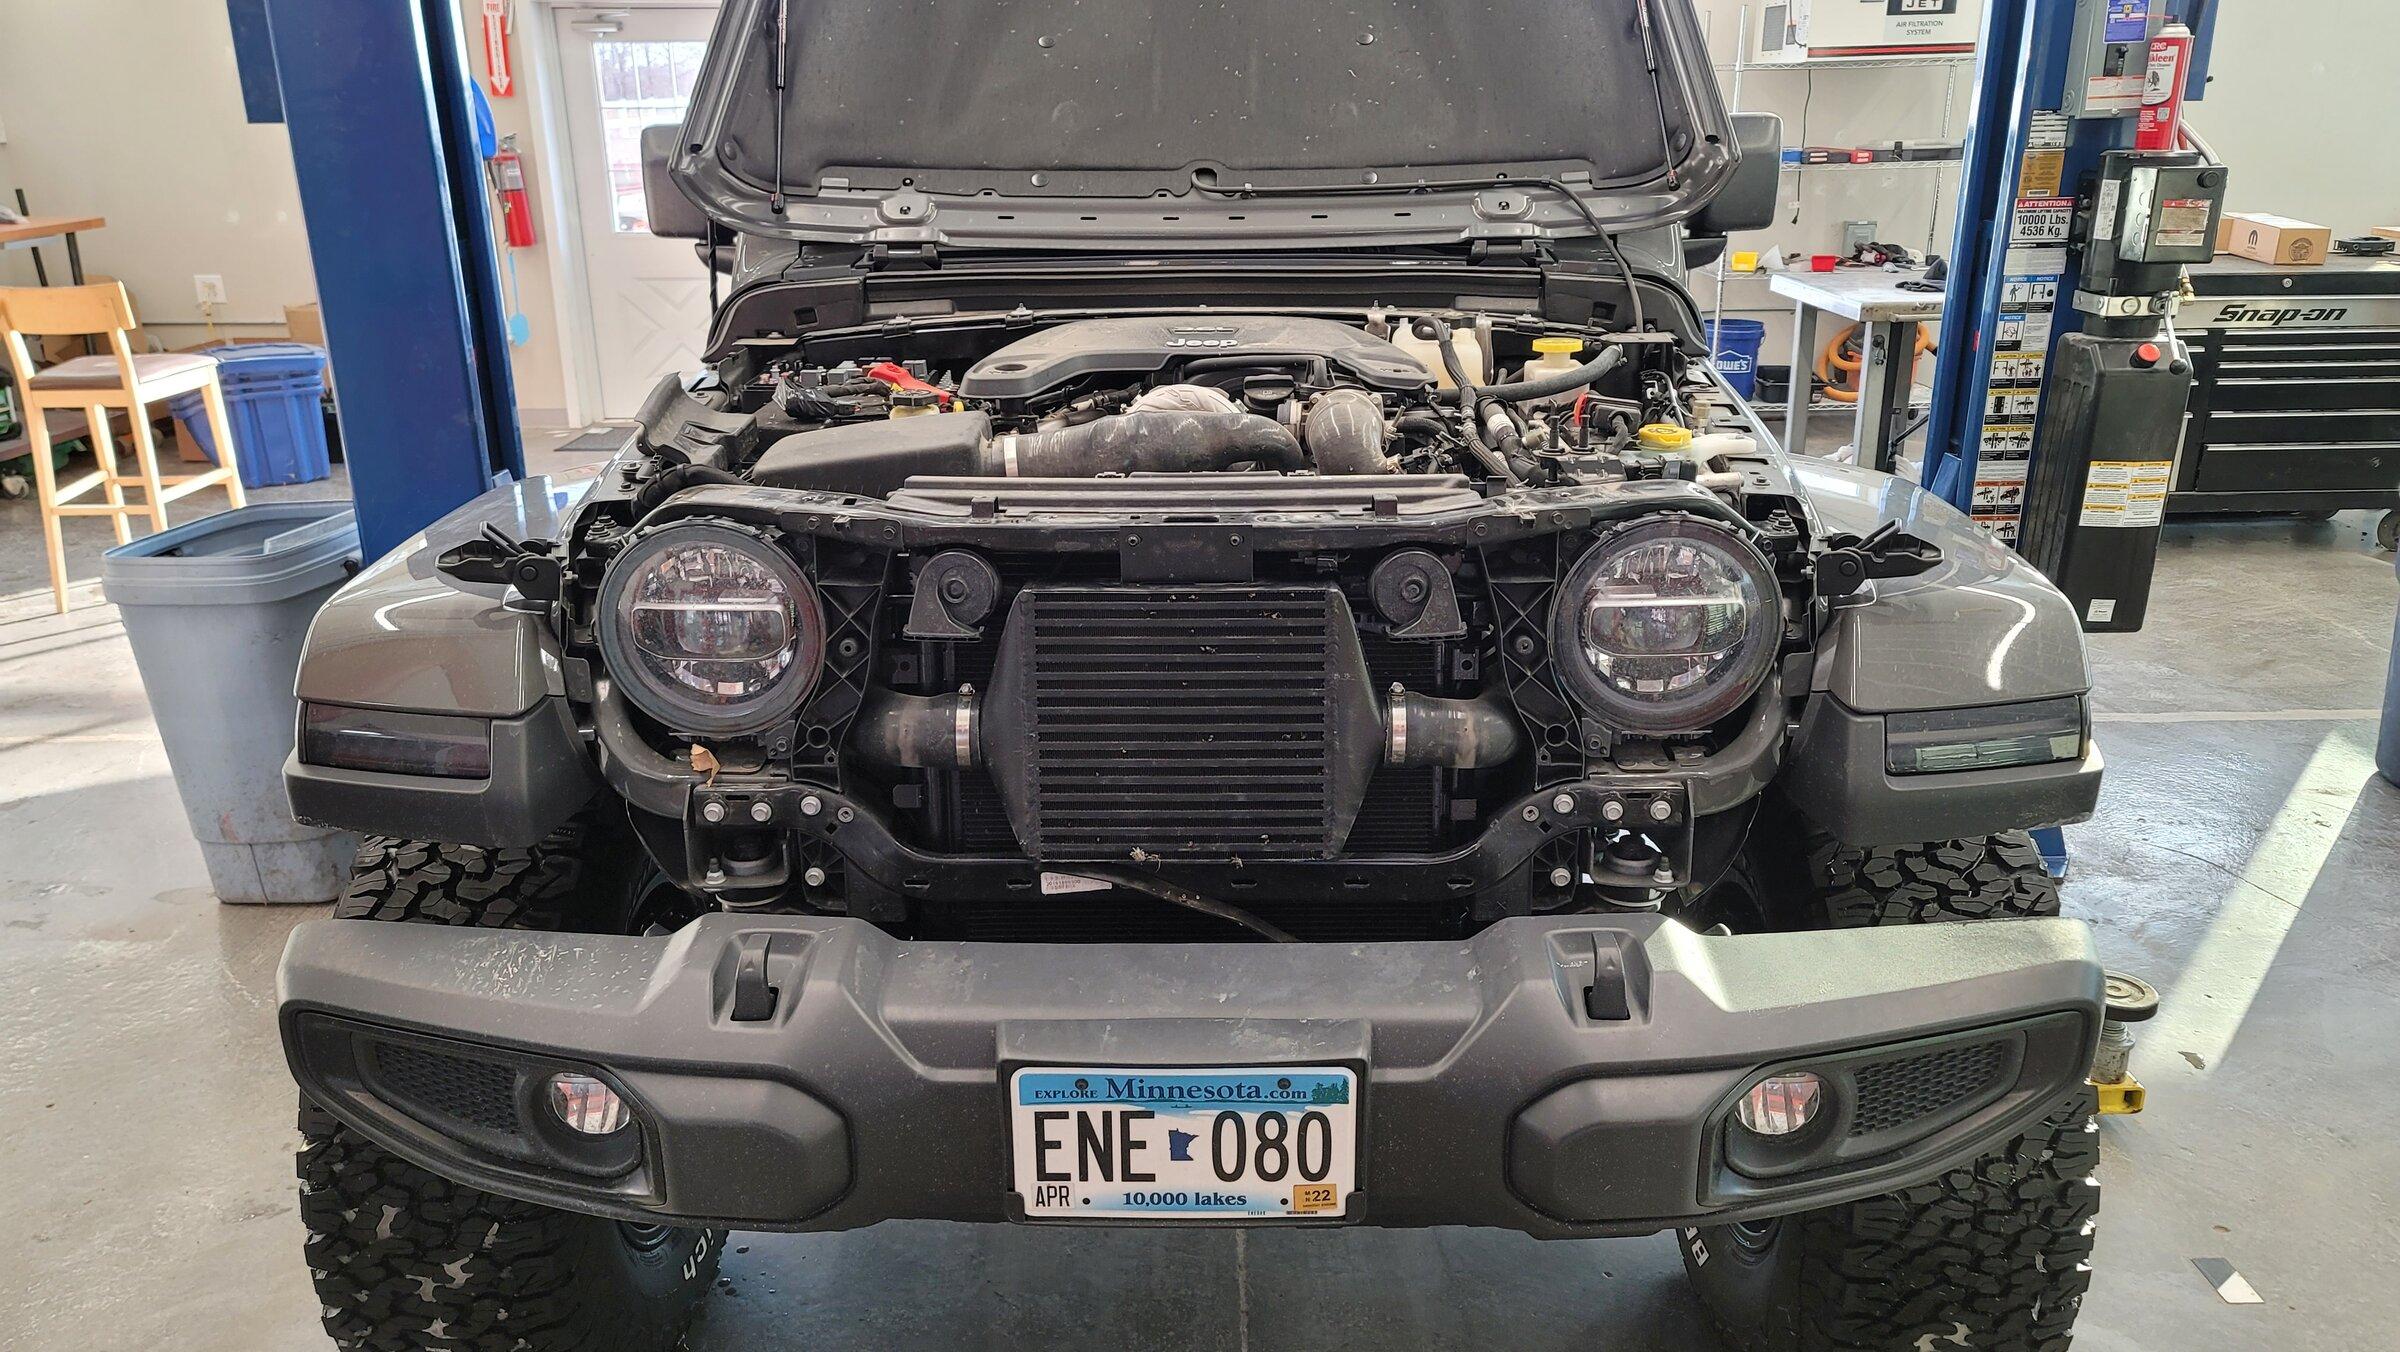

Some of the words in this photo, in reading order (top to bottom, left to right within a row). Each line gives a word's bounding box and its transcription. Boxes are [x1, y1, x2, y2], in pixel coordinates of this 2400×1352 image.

[486, 3, 500, 12] FIRE
[2017, 214, 2046, 225] 10000
[2049, 214, 2068, 225] Lbs.
[2020, 225, 2044, 236] 4536
[2047, 225, 2062, 237] Kg.
[2213, 304, 2348, 325] Snap-on
[1166, 338, 1238, 348] Jeep
[1716, 359, 1749, 370] OWE'S
[1035, 1089, 1098, 1099] EXPLORE
[1034, 1110, 1156, 1182] ENE
[1212, 1110, 1332, 1182] 080
[1035, 1185, 1070, 1207] APR
[1123, 1192, 1188, 1207] 10,000
[1195, 1191, 1247, 1206] lakes
[1312, 1189, 1331, 1202] 22
